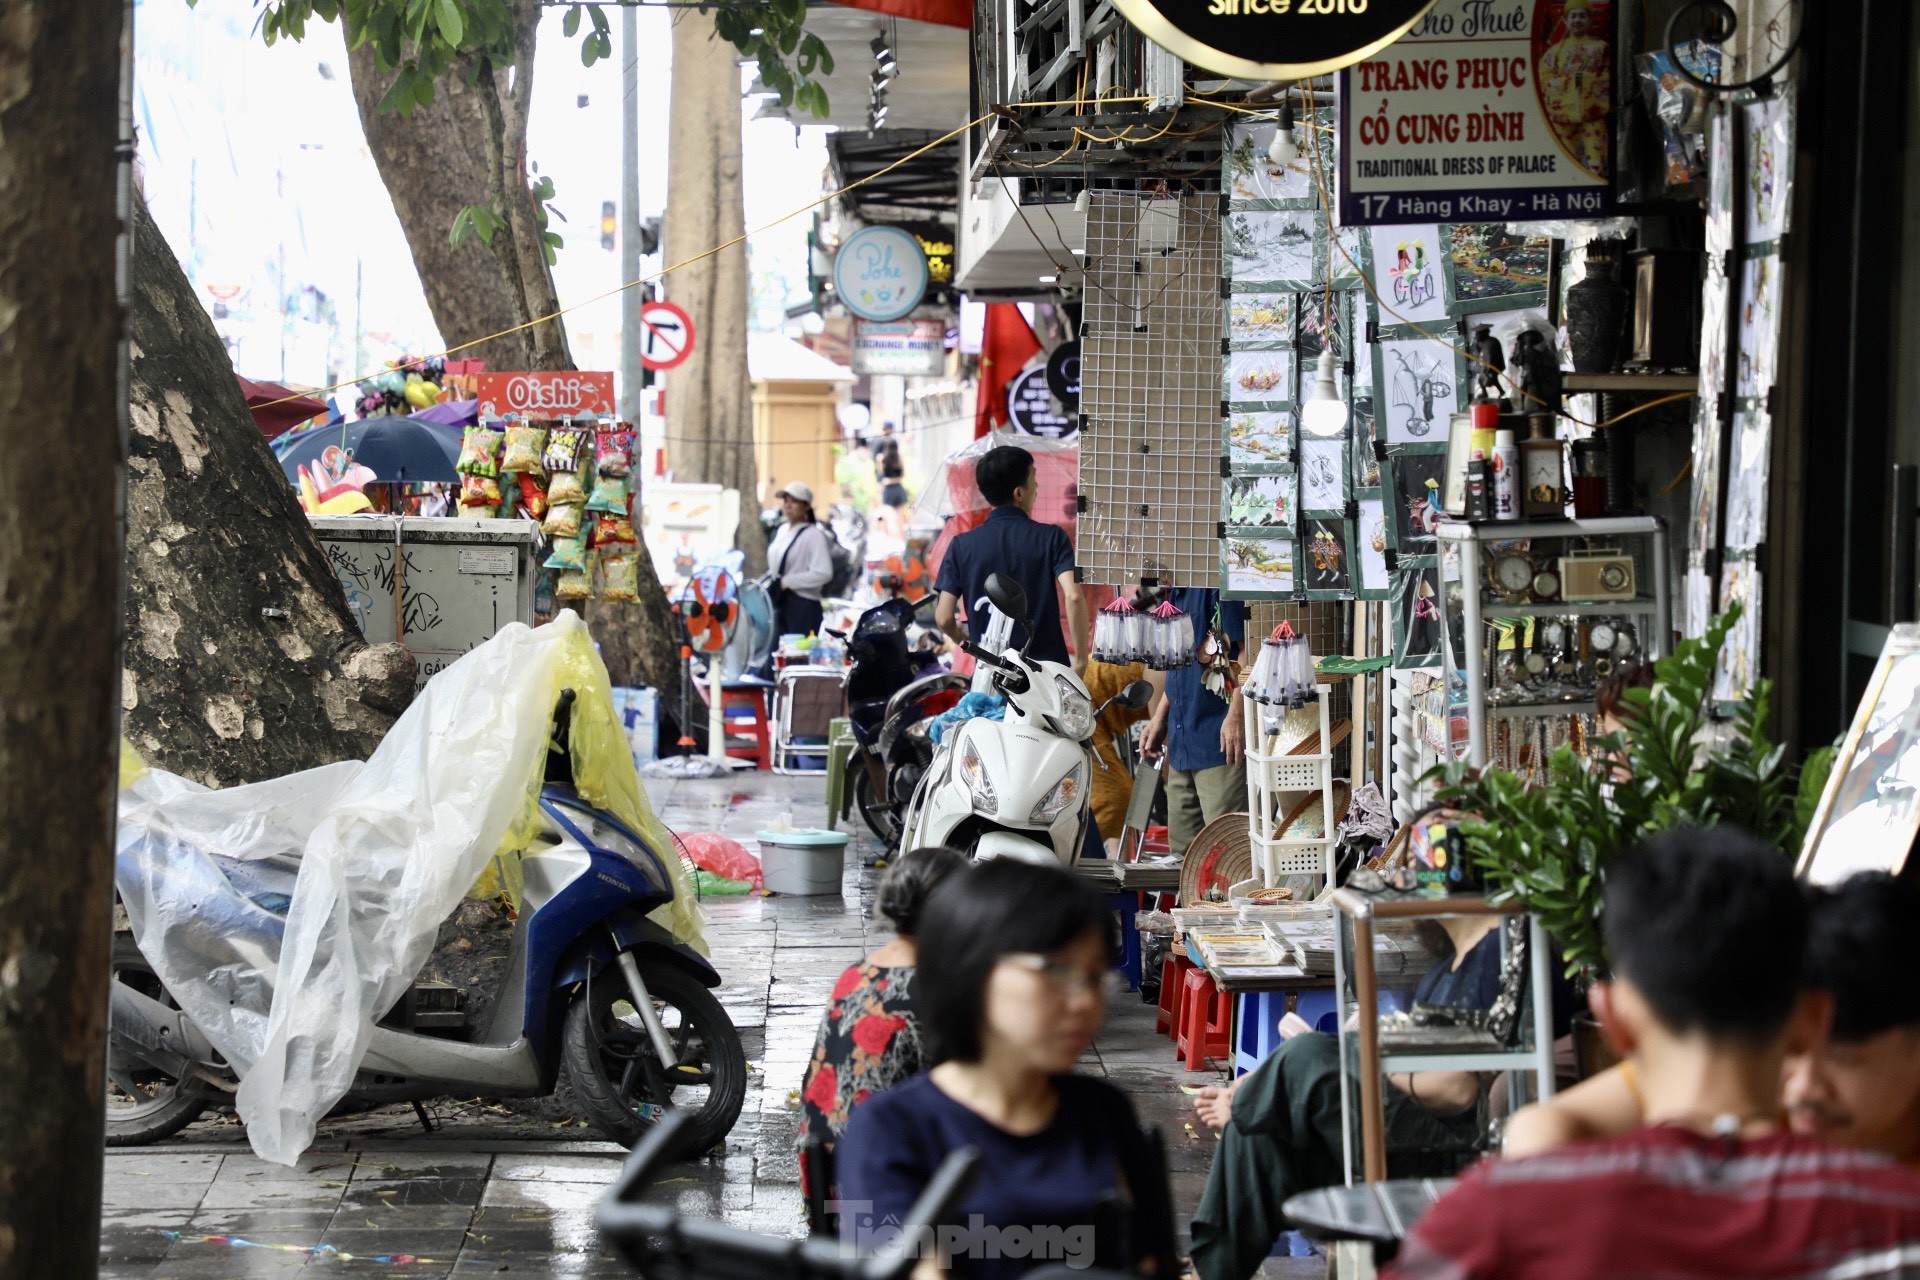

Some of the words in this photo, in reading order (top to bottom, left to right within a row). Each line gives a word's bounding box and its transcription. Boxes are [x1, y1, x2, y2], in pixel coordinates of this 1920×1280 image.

[1208, 0, 1290, 15] Since
[1298, 0, 1368, 14] 2010
[1462, 0, 1528, 37] Thuê
[1358, 60, 1449, 92] TRANG
[1456, 57, 1526, 97] PHỤC
[1359, 98, 1390, 145] CỔ
[1396, 114, 1460, 144] CUNG
[1466, 104, 1525, 142] ĐÌNH
[1357, 158, 1438, 178] TRADITIONAL
[1443, 156, 1484, 175] DRESS
[1489, 156, 1504, 174] OF
[1508, 154, 1556, 173] PALACE
[1359, 195, 1390, 219] 17
[1397, 197, 1452, 217] Hàng
[1459, 196, 1512, 216] Khay
[1532, 193, 1560, 211] Hà
[1567, 192, 1601, 210] Nội
[506, 376, 582, 410] Oishi
[597, 872, 631, 892] HONDA
